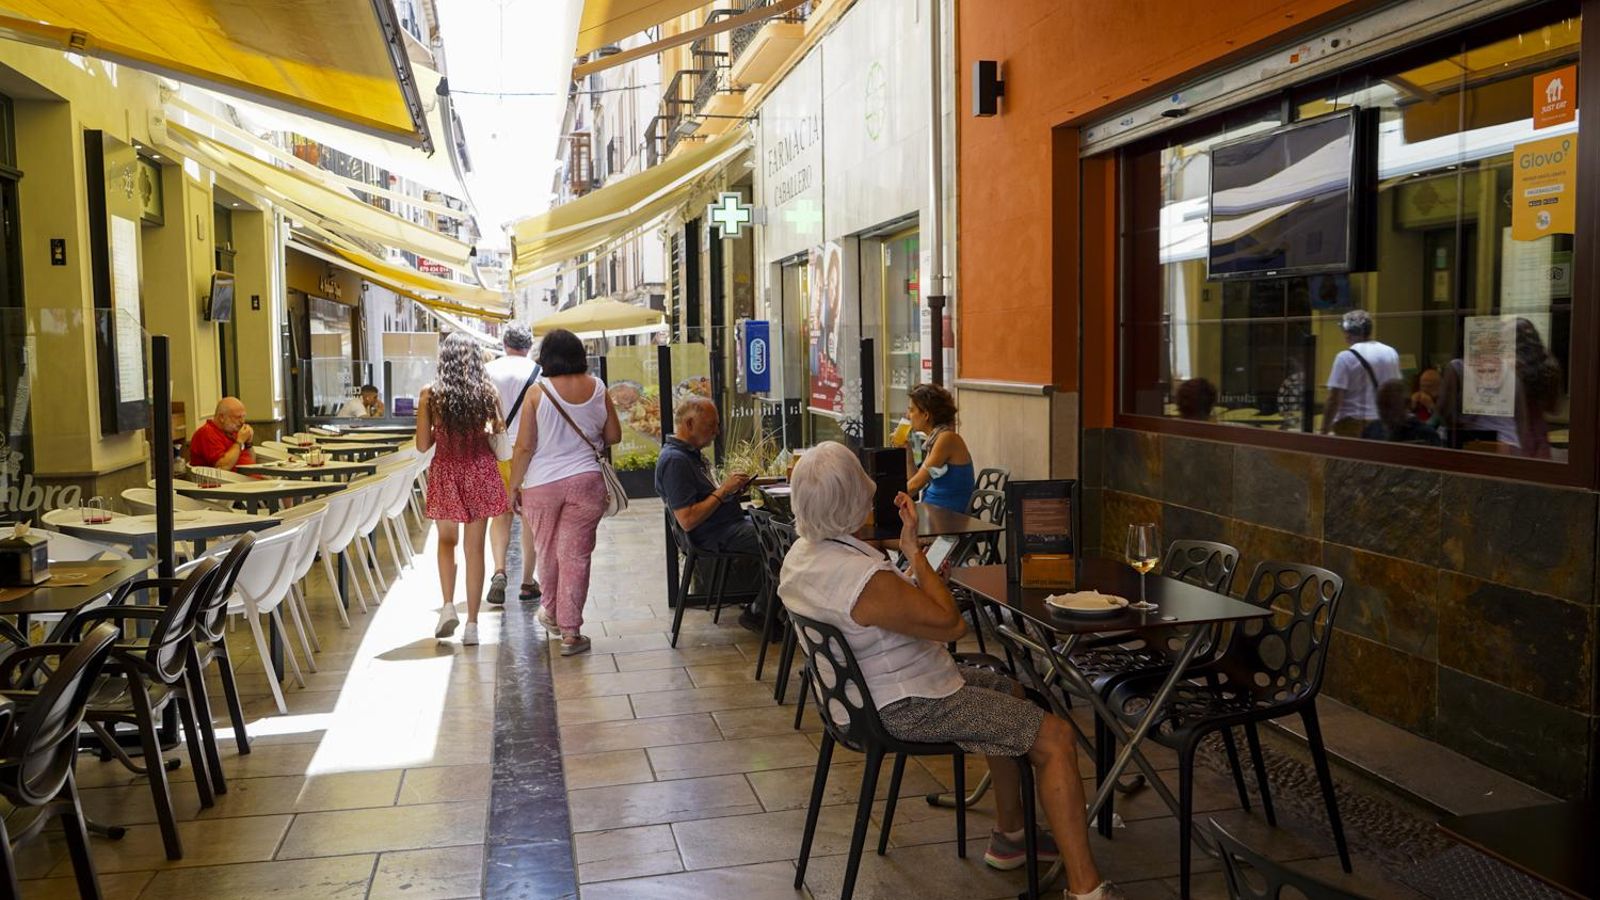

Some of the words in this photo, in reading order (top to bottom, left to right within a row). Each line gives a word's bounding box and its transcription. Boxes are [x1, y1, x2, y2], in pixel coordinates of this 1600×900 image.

[768, 113, 819, 178] FARMACIA
[1519, 151, 1564, 169] Glovo
[774, 164, 813, 207] CABALLERO
[753, 340, 764, 372] durex
